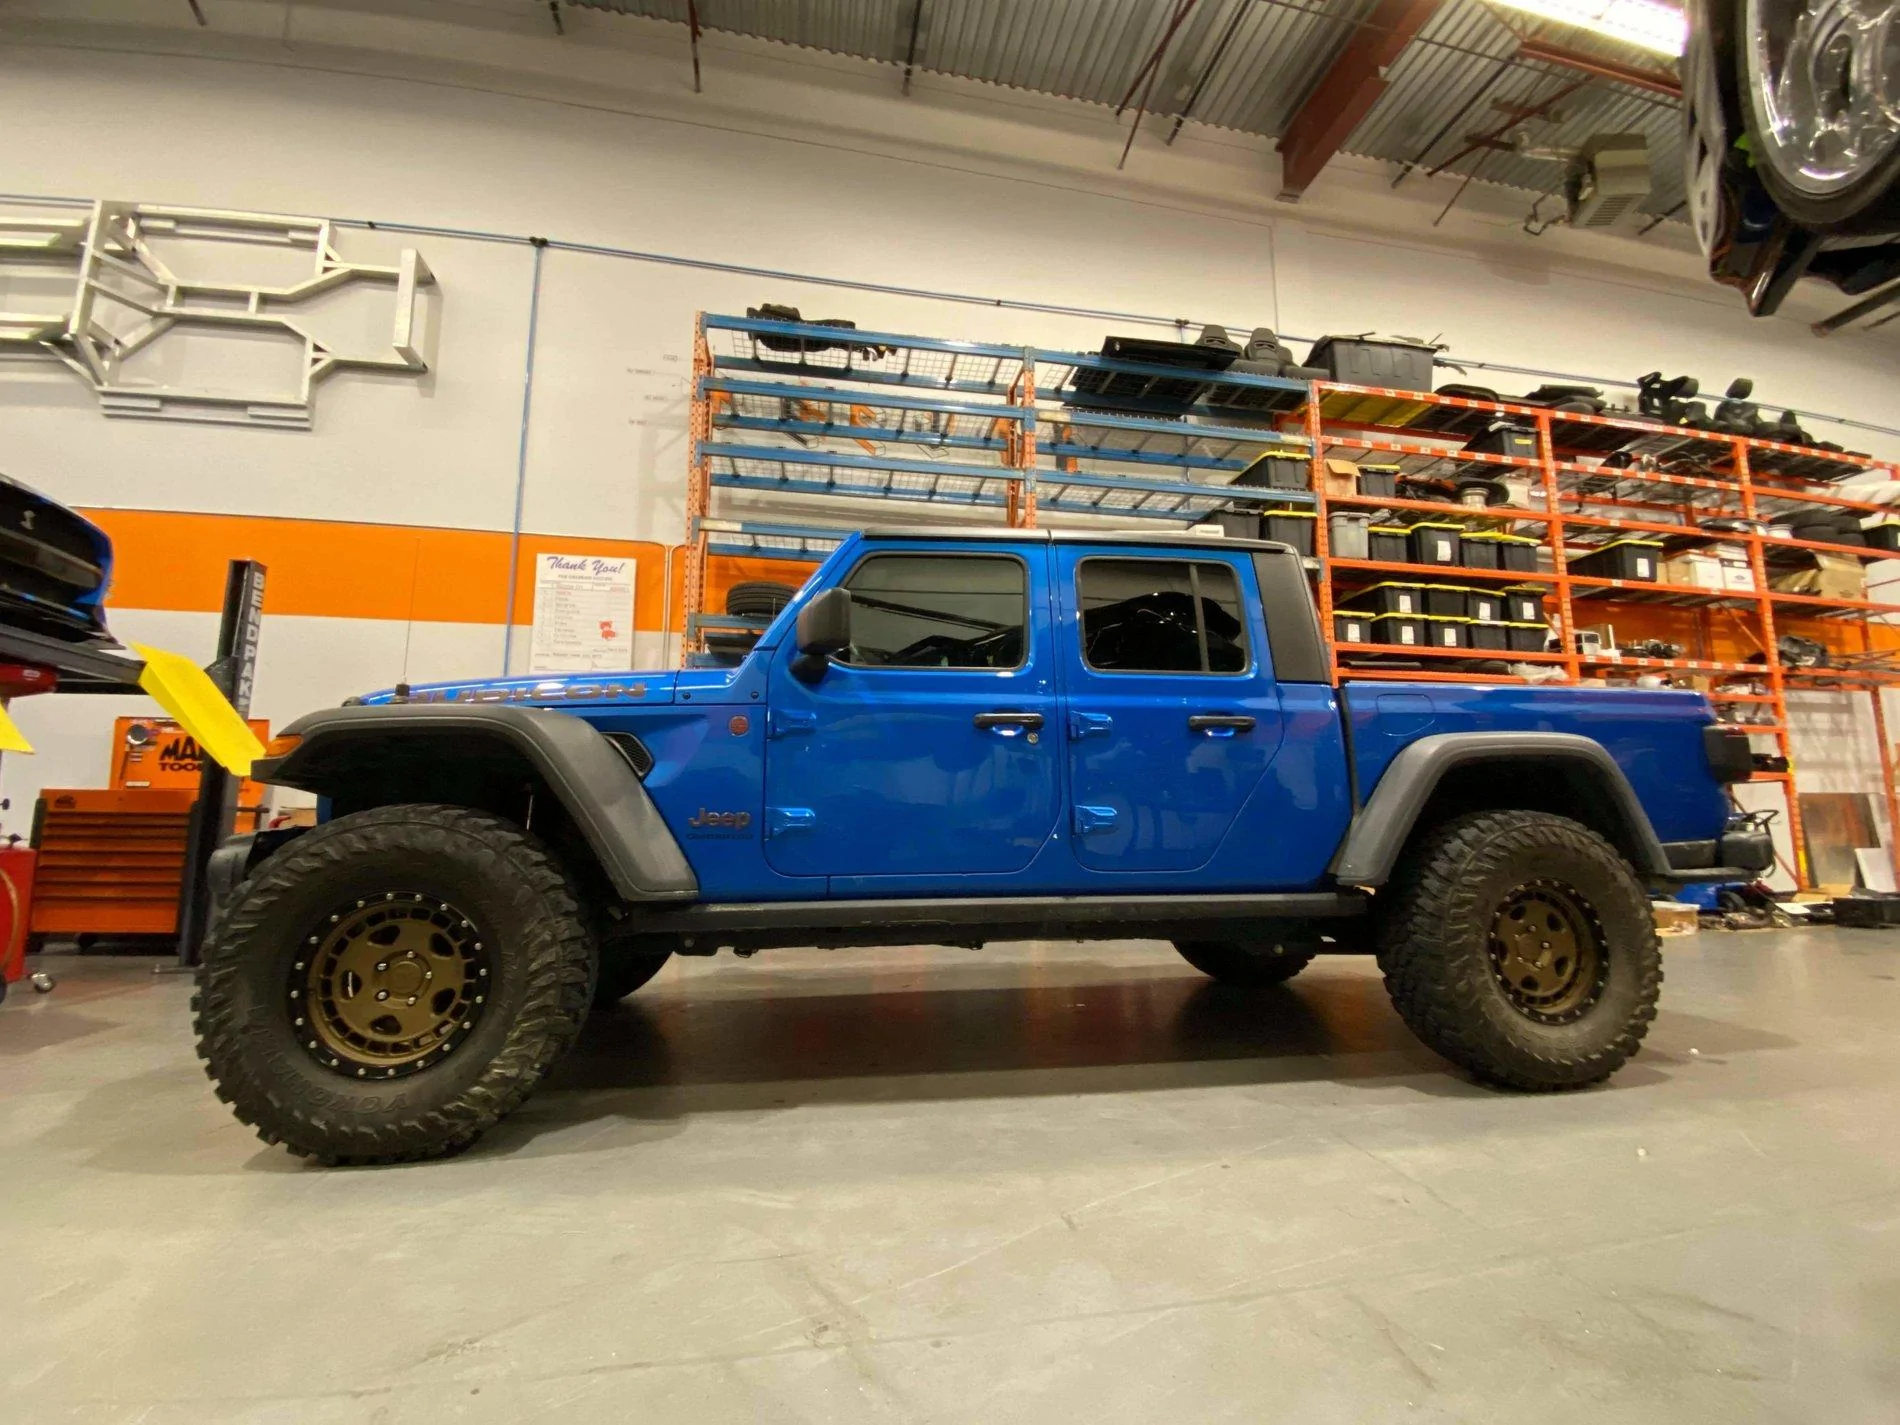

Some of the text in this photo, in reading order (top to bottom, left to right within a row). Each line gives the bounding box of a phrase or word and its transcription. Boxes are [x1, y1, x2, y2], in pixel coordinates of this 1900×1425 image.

[546, 556, 626, 576] Thank You!
[159, 736, 203, 761] MA
[687, 807, 751, 831] Jeep
